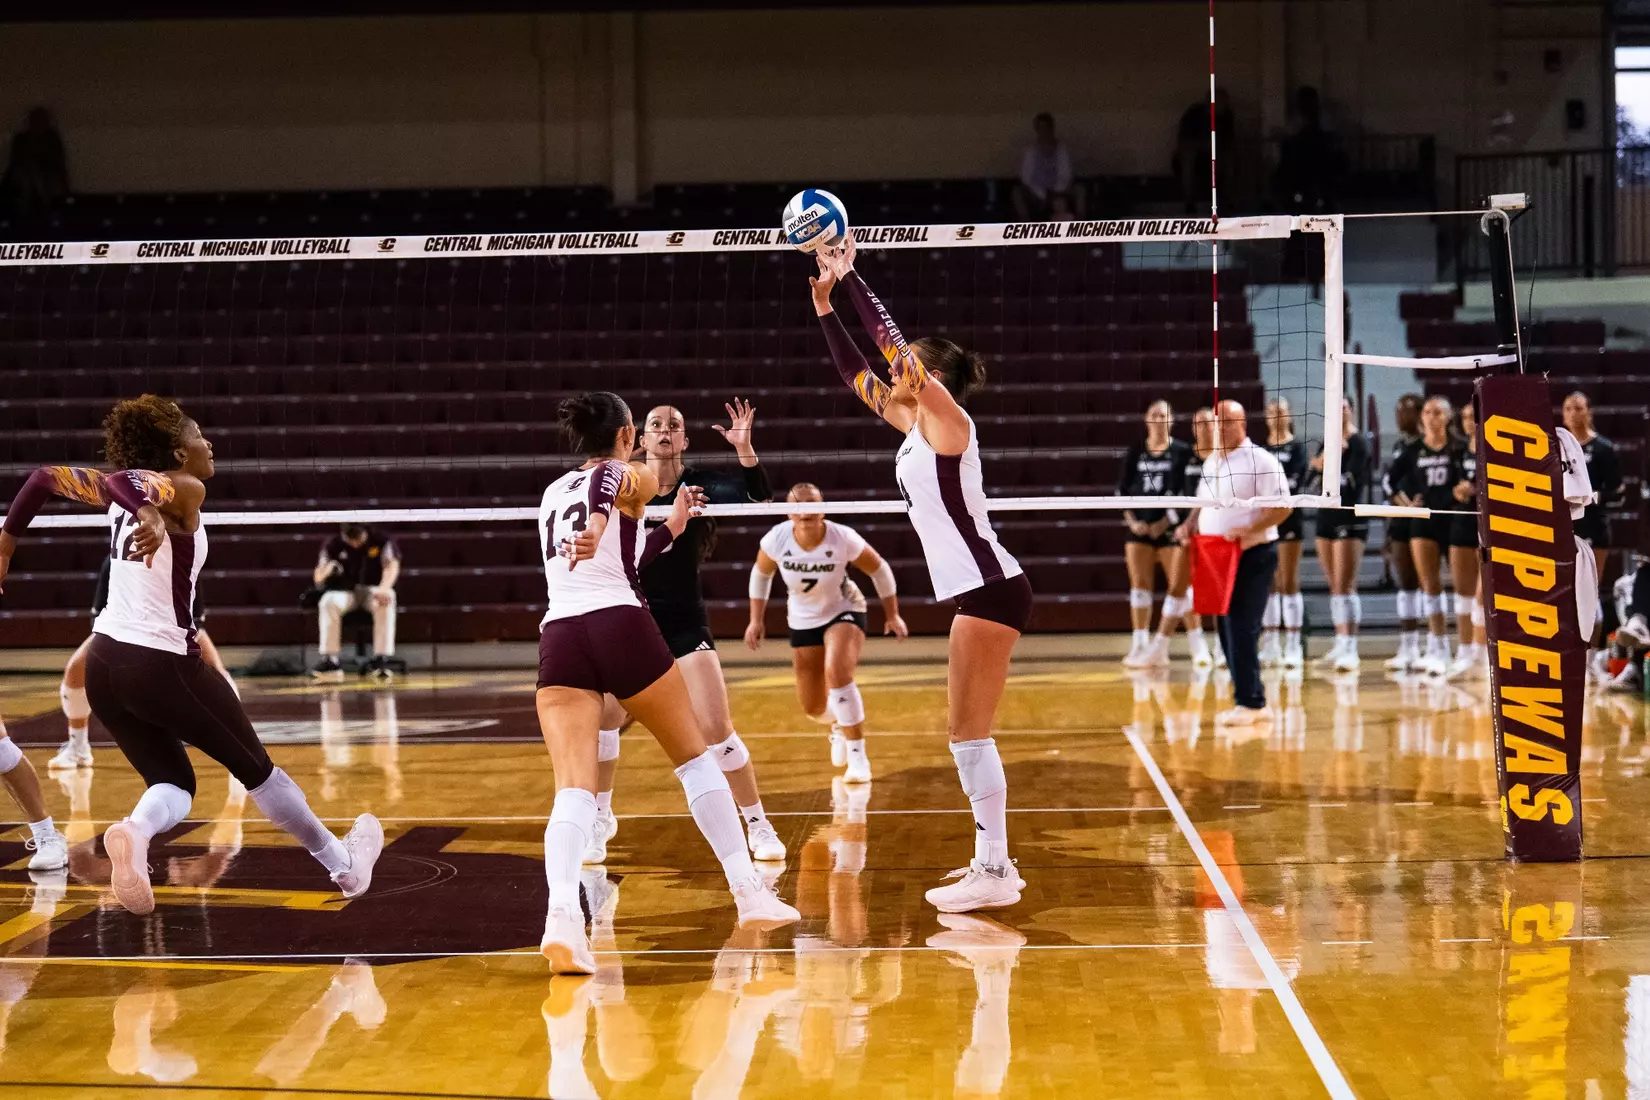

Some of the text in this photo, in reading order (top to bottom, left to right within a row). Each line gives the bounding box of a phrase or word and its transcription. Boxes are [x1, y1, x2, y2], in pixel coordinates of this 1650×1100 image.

[788, 210, 818, 233] molten
[795, 220, 822, 241] NCAA
[1002, 218, 1219, 239] CENTRAL MICHIGAN VOLLEYBALL
[136, 238, 352, 258] CENTRAL MICHIGAN VOLLEYBALL
[424, 232, 639, 252] CENTRAL MICHIGAN VOLLEYBALL
[712, 230, 772, 246] CENTRAL
[1426, 466, 1448, 487] 10
[110, 511, 146, 562] 12
[545, 501, 587, 561] 13
[783, 561, 835, 572] OAKLAND
[801, 578, 818, 593] 7
[1484, 414, 1574, 826] CHIPPEWAS
